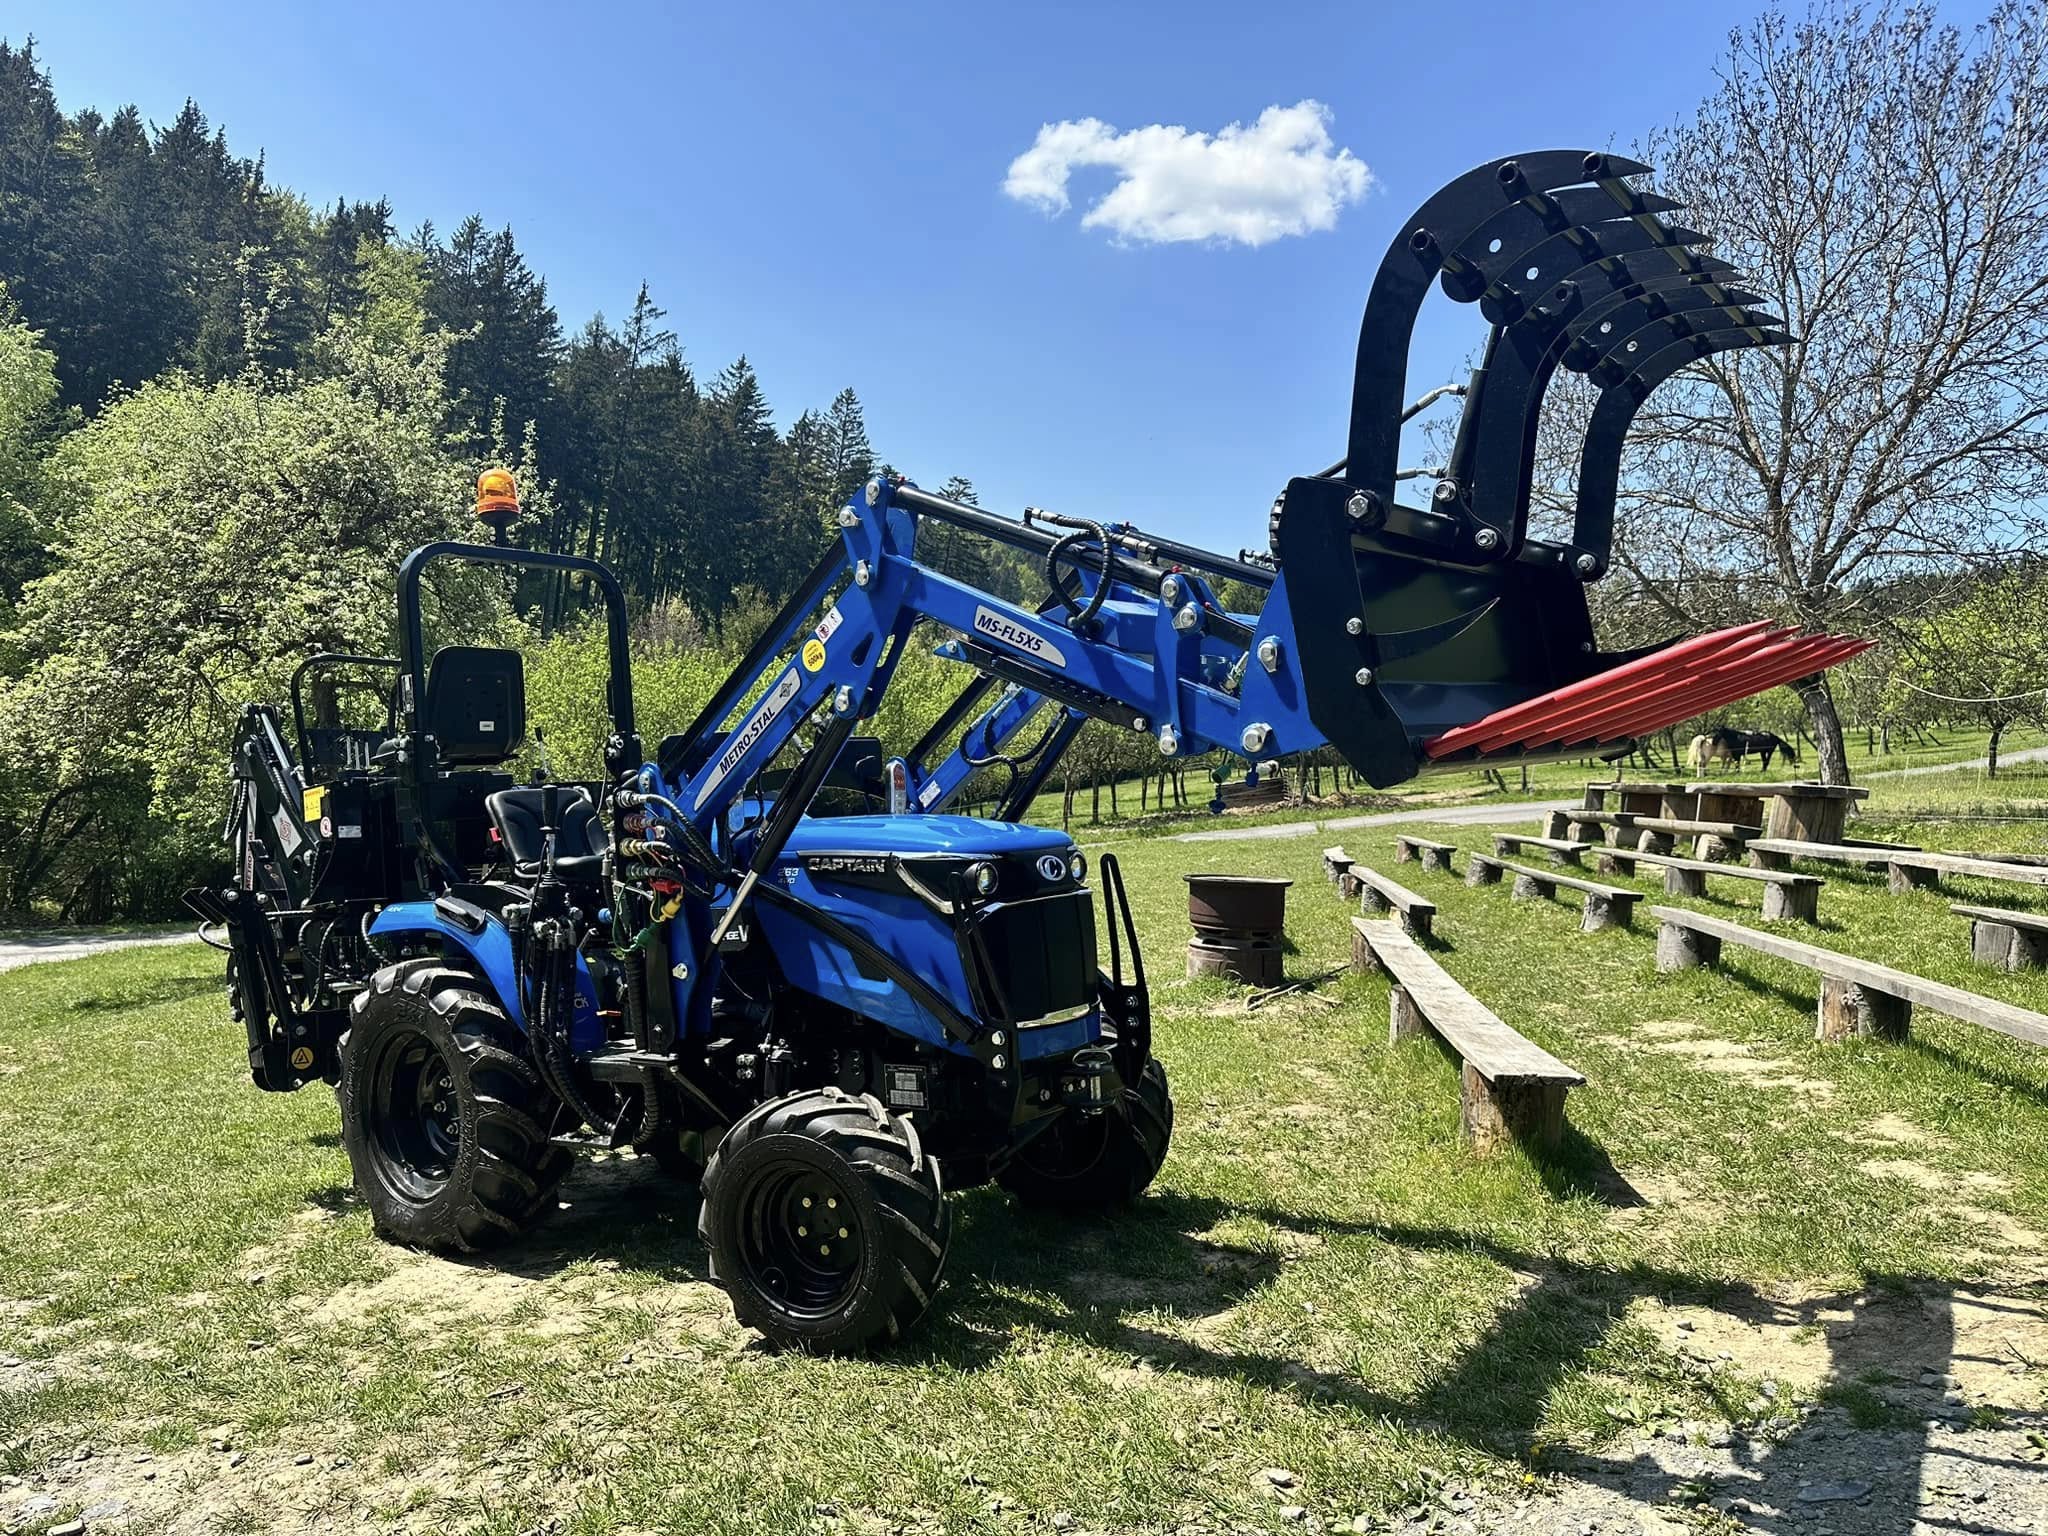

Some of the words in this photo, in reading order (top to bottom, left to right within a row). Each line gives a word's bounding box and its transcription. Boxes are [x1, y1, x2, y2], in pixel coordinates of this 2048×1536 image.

[977, 615, 1044, 651] MS-FL5X5
[719, 707, 775, 775] METRO-STAL
[808, 858, 885, 873] CAPTAIN
